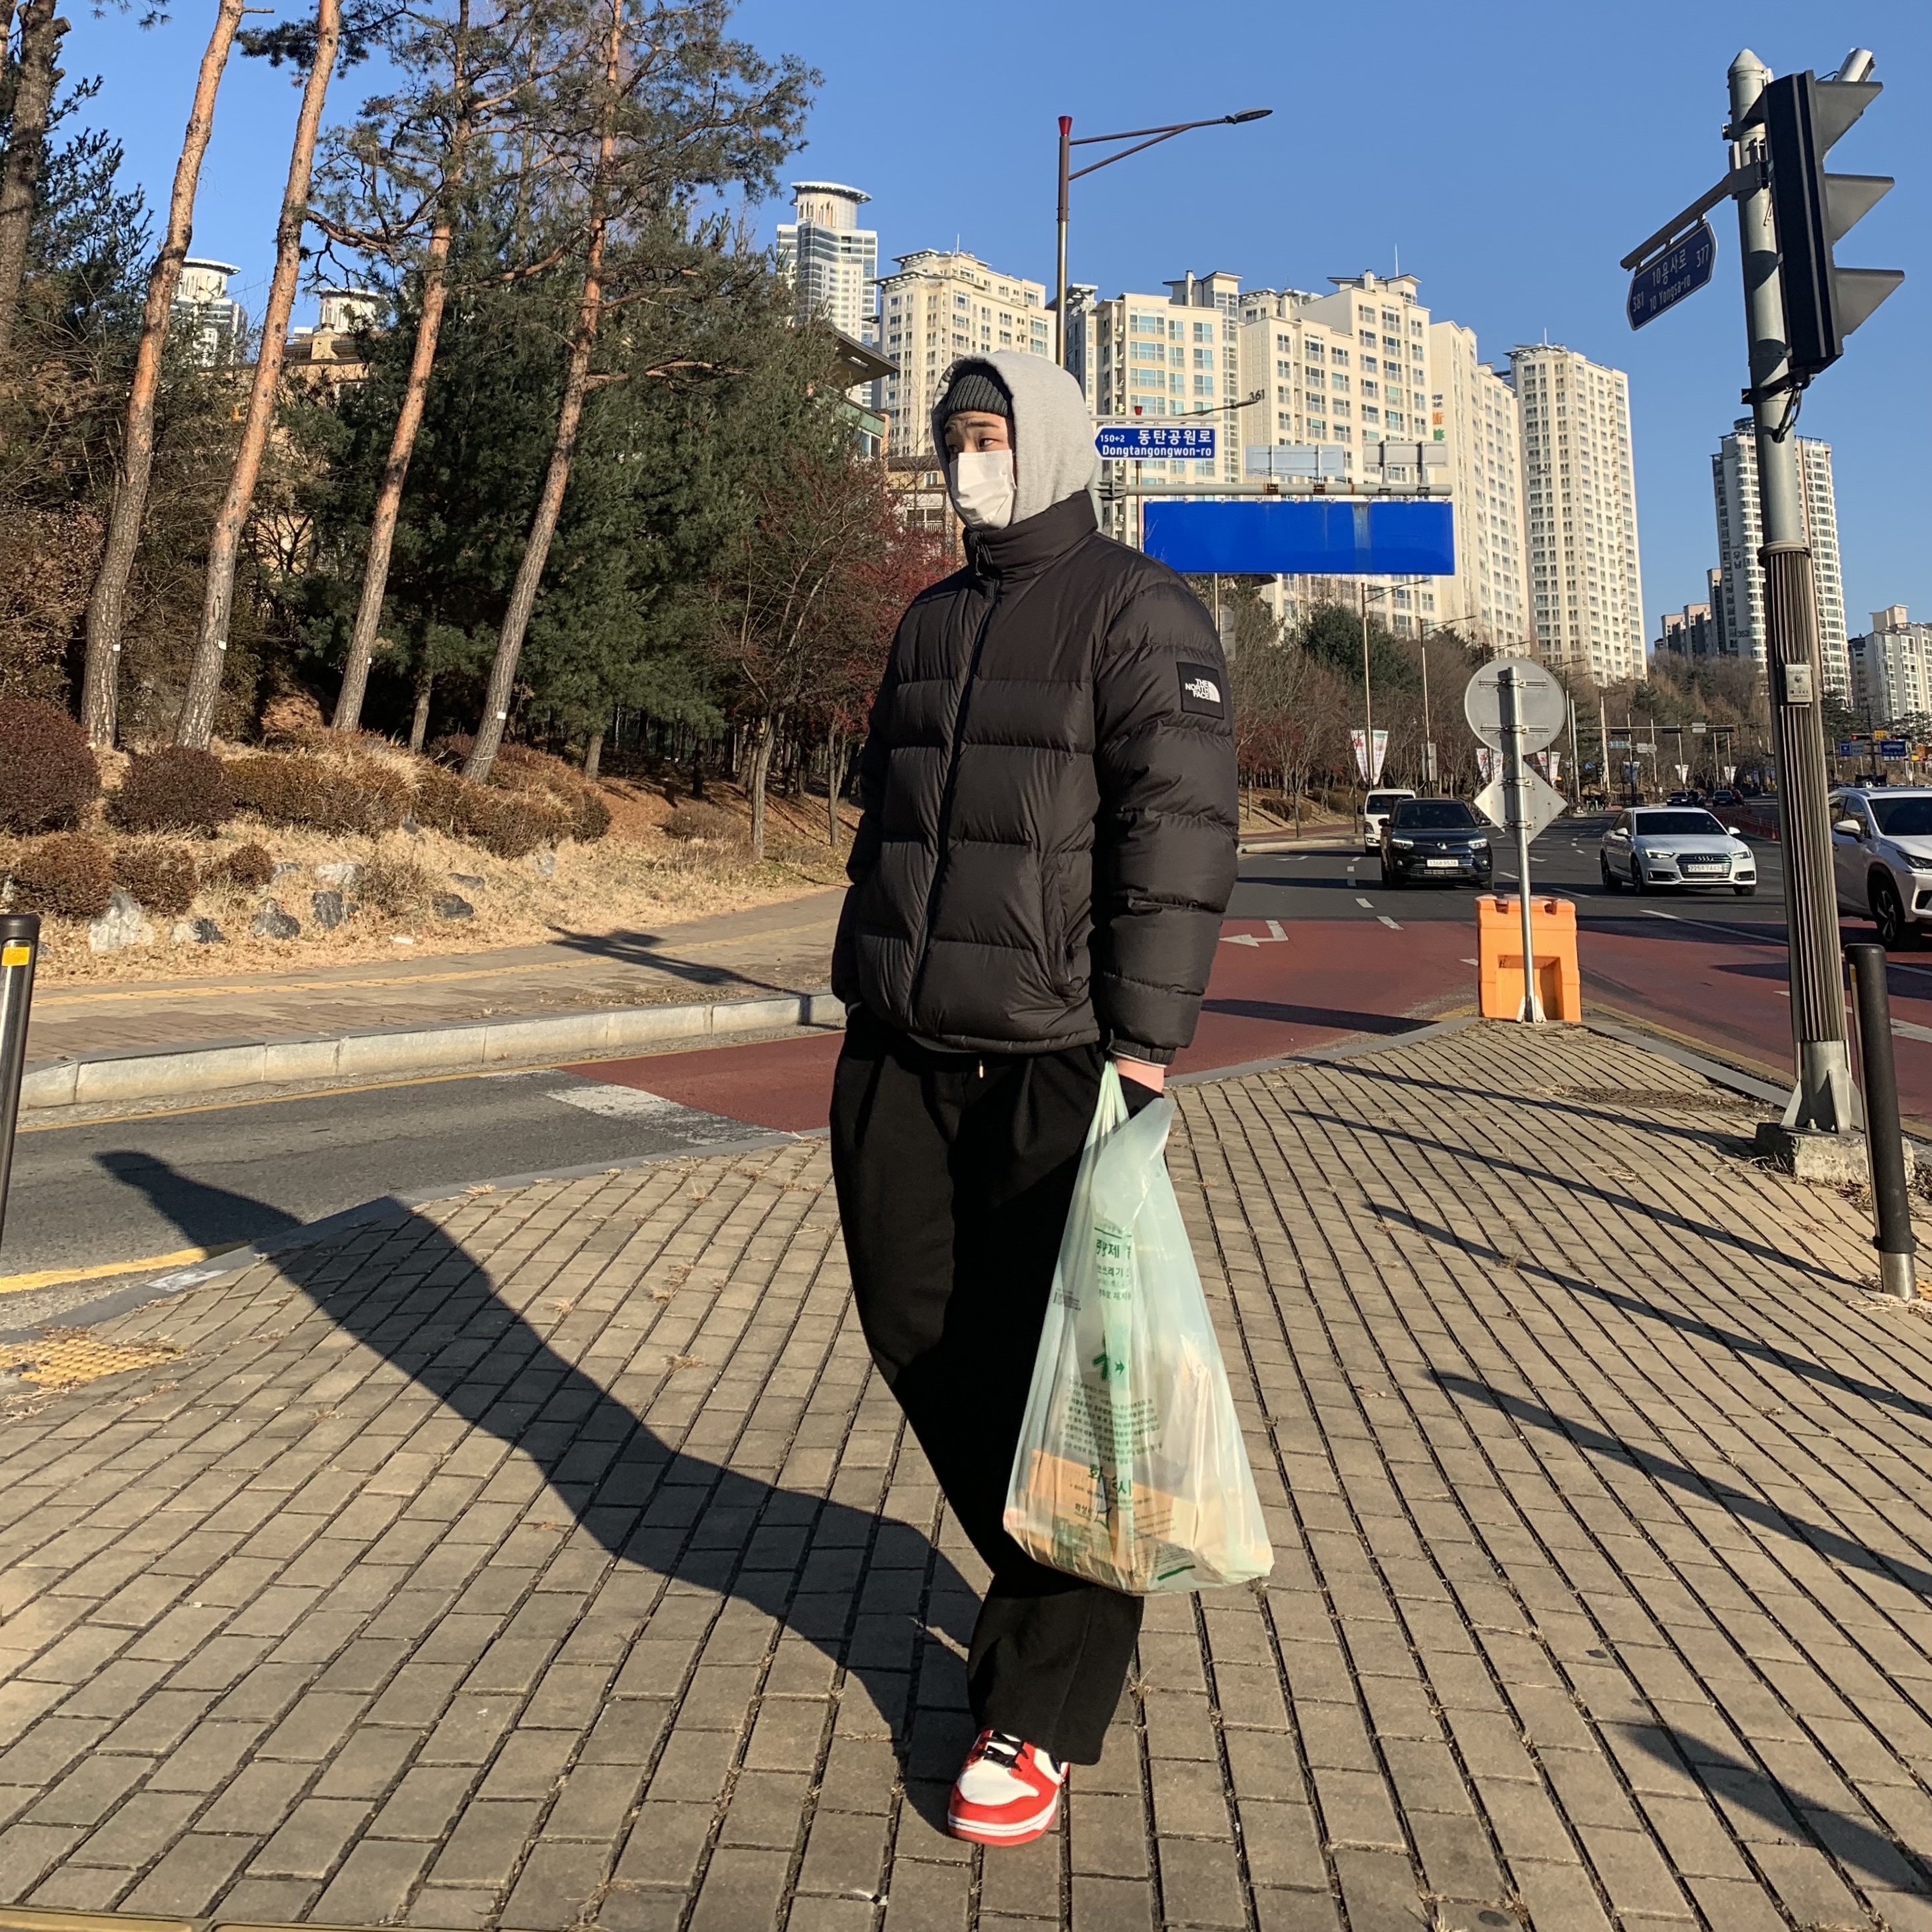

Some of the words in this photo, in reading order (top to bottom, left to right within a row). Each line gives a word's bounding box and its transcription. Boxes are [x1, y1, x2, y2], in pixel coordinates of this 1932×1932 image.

[1696, 243, 1709, 268] 377
[1653, 249, 1687, 287] 10용사로
[1650, 295, 1657, 312] 10
[1659, 274, 1691, 305] Yongsa-ro
[1633, 291, 1644, 313] 381
[1248, 389, 1265, 401] 361
[1137, 429, 1212, 445] 동탄공원로
[1102, 445, 1212, 458] Dongtangongwon-ro
[1737, 630, 1749, 638] 352
[1185, 683, 1209, 693] NORTH
[1195, 678, 1209, 687] THE
[1193, 691, 1210, 700] FACE
